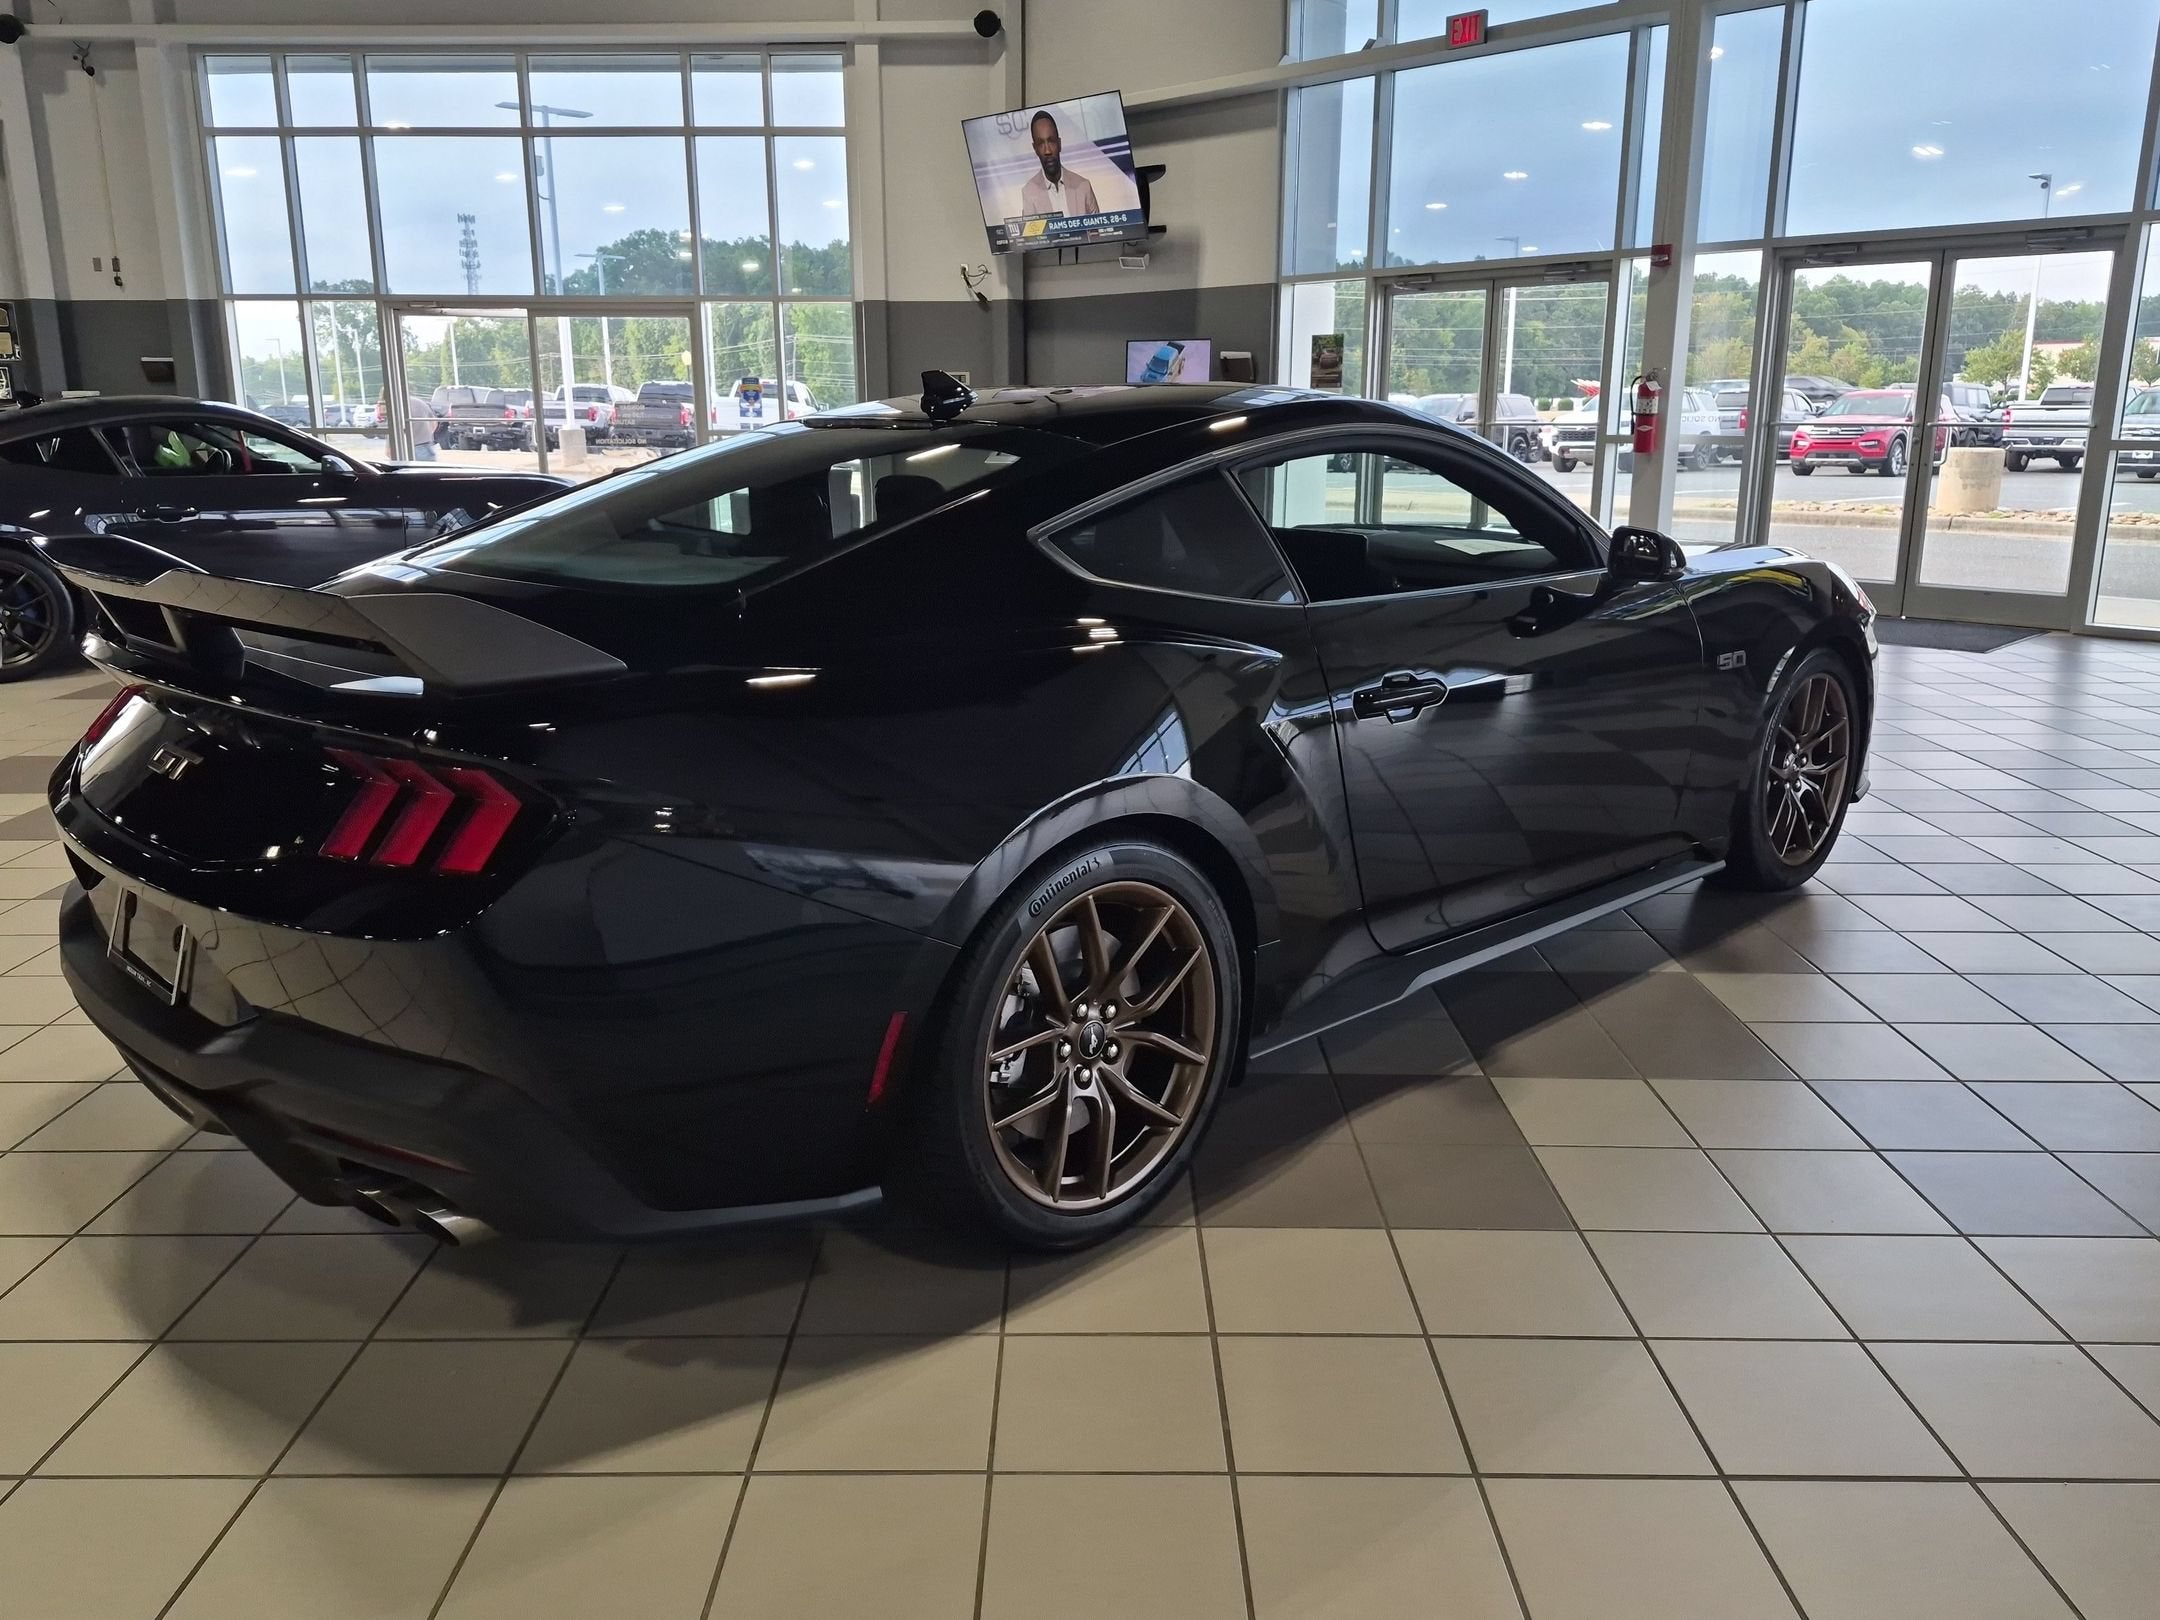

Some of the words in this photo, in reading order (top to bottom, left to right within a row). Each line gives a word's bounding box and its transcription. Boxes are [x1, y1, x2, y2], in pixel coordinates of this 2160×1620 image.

[1451, 14, 1480, 45] EXIT
[1049, 219, 1068, 230] RAMS
[1068, 218, 1084, 228] DEF.
[1083, 215, 1110, 227] GIANTS,
[1110, 213, 1128, 223] 28-6
[147, 743, 203, 781] GT
[1028, 860, 1092, 918] Continental
